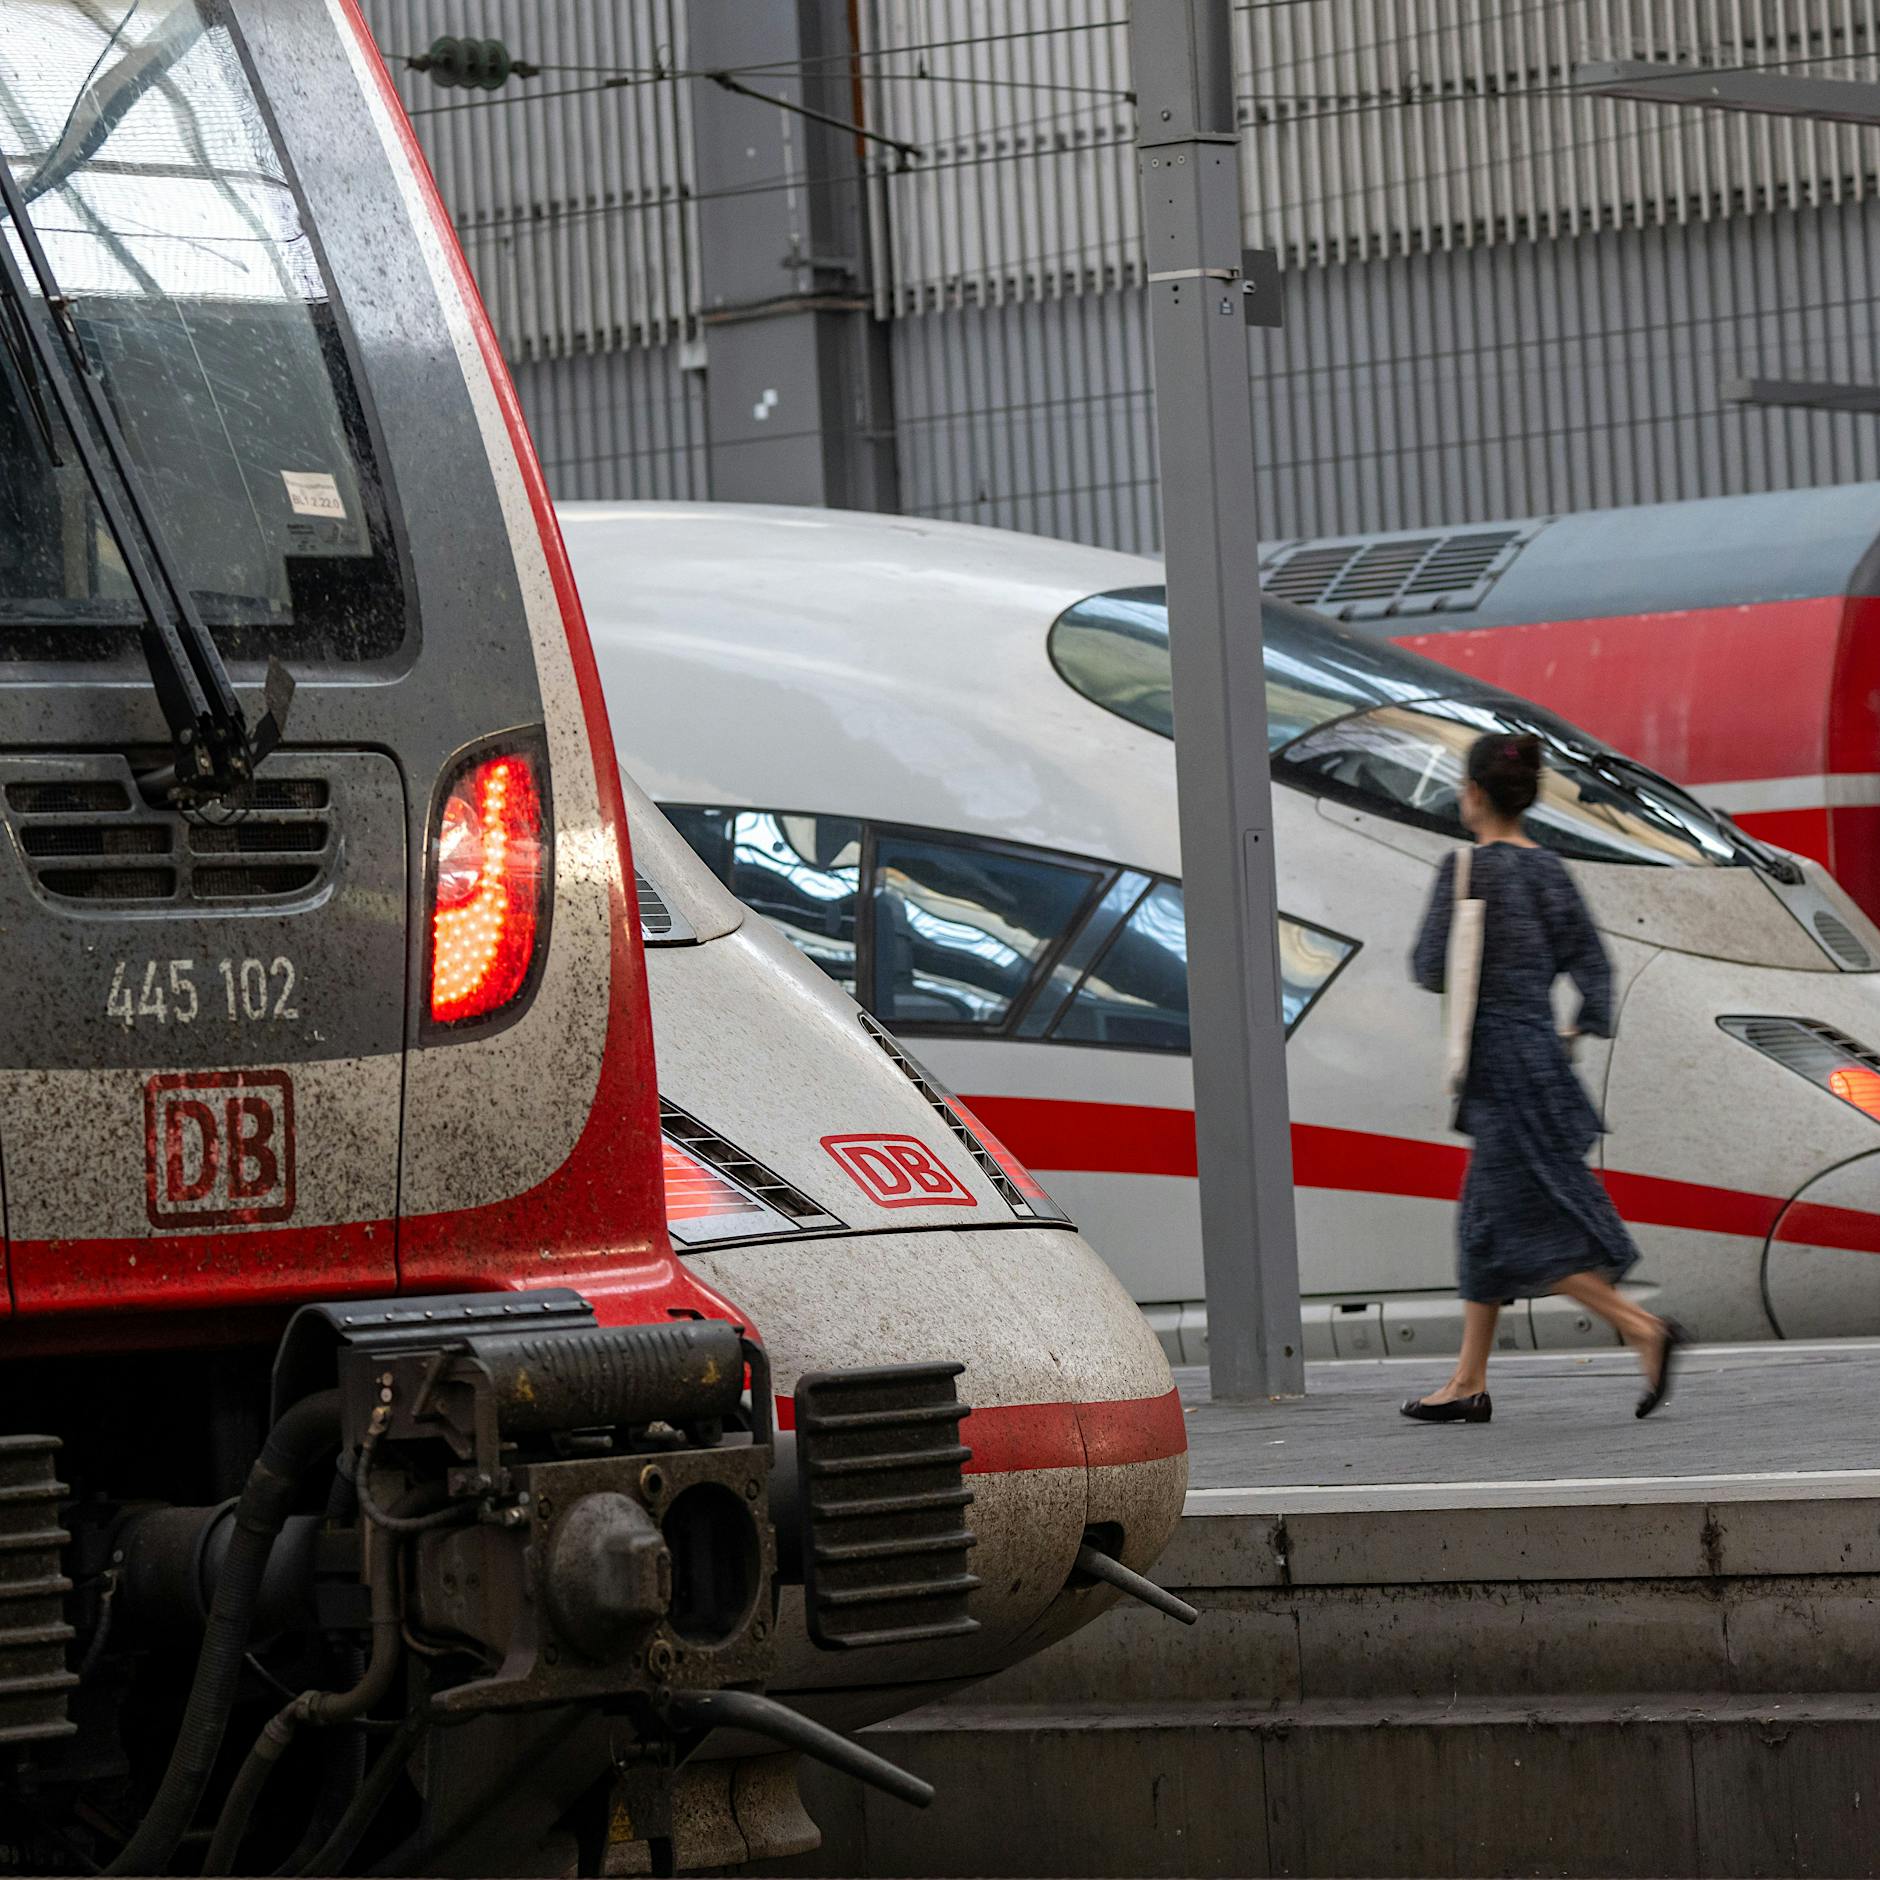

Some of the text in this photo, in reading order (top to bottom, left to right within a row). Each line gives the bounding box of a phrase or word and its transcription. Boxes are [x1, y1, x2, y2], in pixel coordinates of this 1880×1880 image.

[107, 956, 299, 1025] 445 102
[163, 1095, 280, 1203] DB
[839, 1144, 955, 1197] DB
